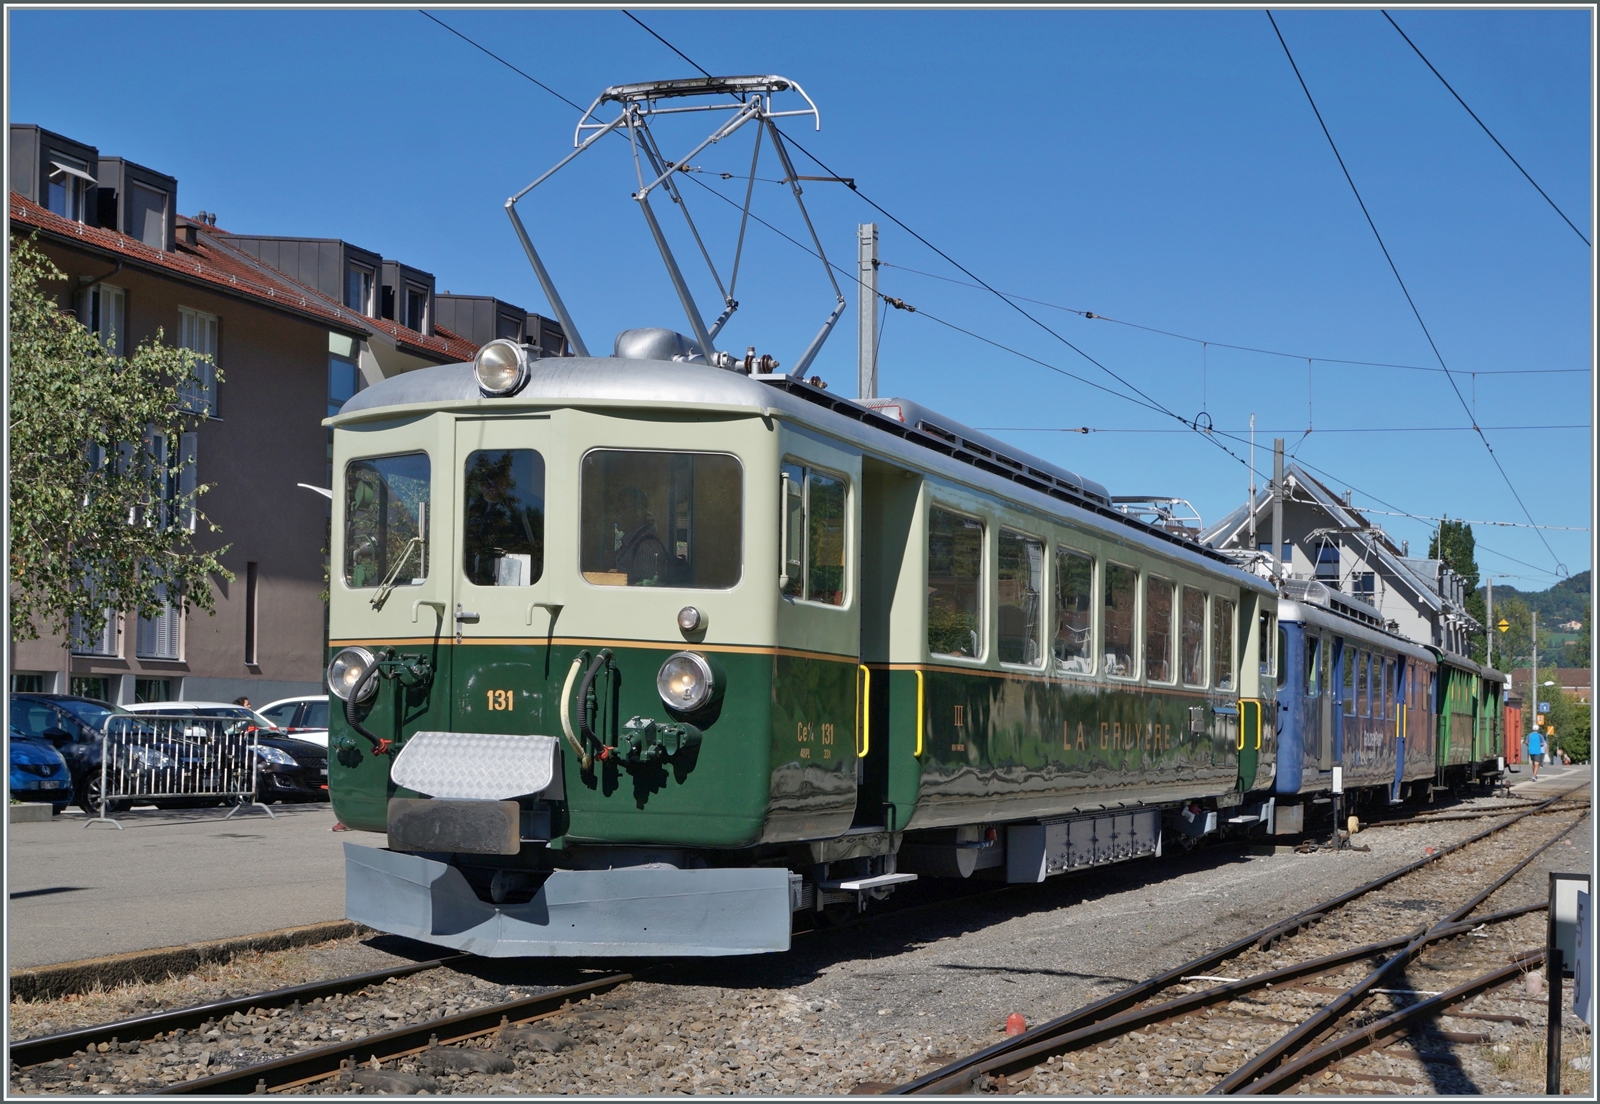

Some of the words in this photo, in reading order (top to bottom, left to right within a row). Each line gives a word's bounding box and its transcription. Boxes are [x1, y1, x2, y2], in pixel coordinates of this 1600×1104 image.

[487, 690, 513, 711] 131
[822, 723, 834, 745] 131
[1064, 720, 1085, 751] LA
